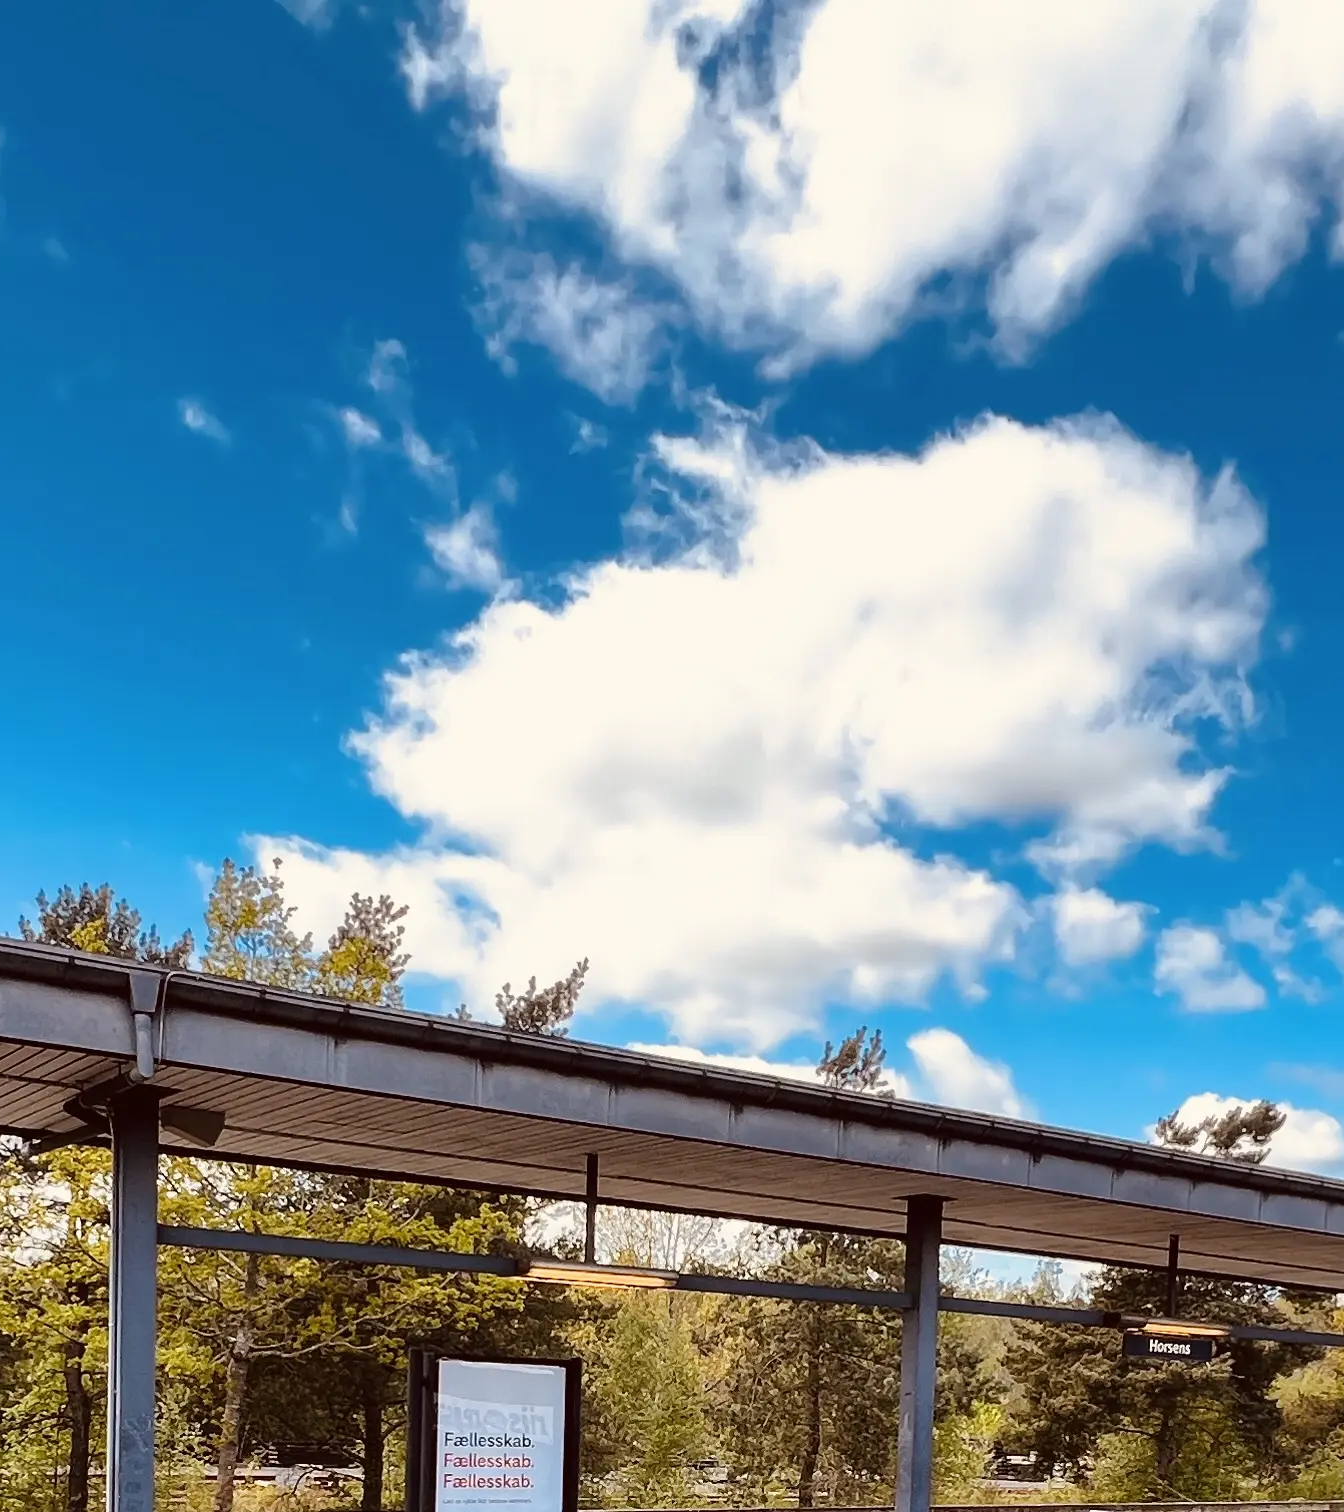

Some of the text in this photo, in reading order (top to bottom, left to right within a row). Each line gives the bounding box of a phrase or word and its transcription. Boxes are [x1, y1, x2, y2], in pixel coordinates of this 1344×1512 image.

[1149, 1339, 1191, 1354] Horsens
[444, 1432, 535, 1448] Fællesskab.
[443, 1453, 535, 1468] Fællesskab.
[443, 1473, 535, 1489] Fællesskab.
